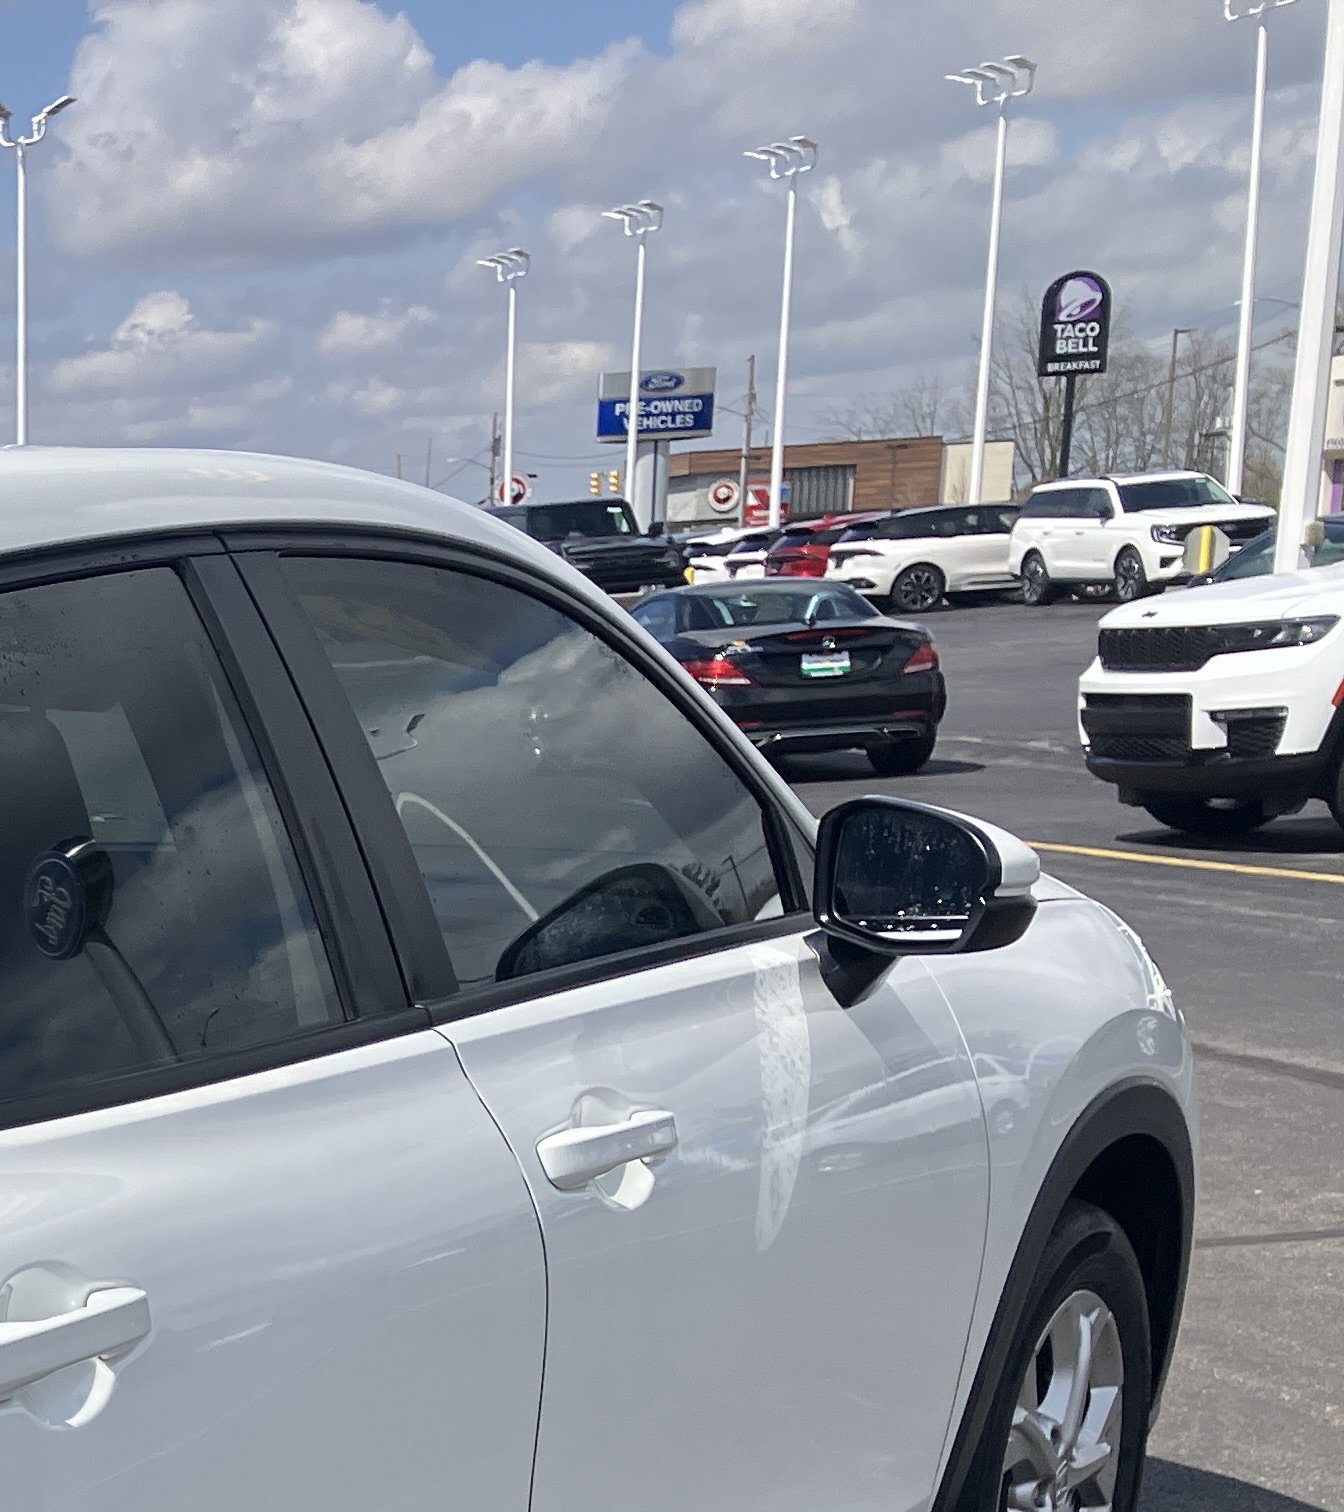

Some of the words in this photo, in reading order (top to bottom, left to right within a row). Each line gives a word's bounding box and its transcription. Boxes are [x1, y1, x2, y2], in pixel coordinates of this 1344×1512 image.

[1053, 321, 1101, 339] TACO
[1055, 337, 1099, 355] BELL
[1047, 360, 1101, 373] BREAKFAST
